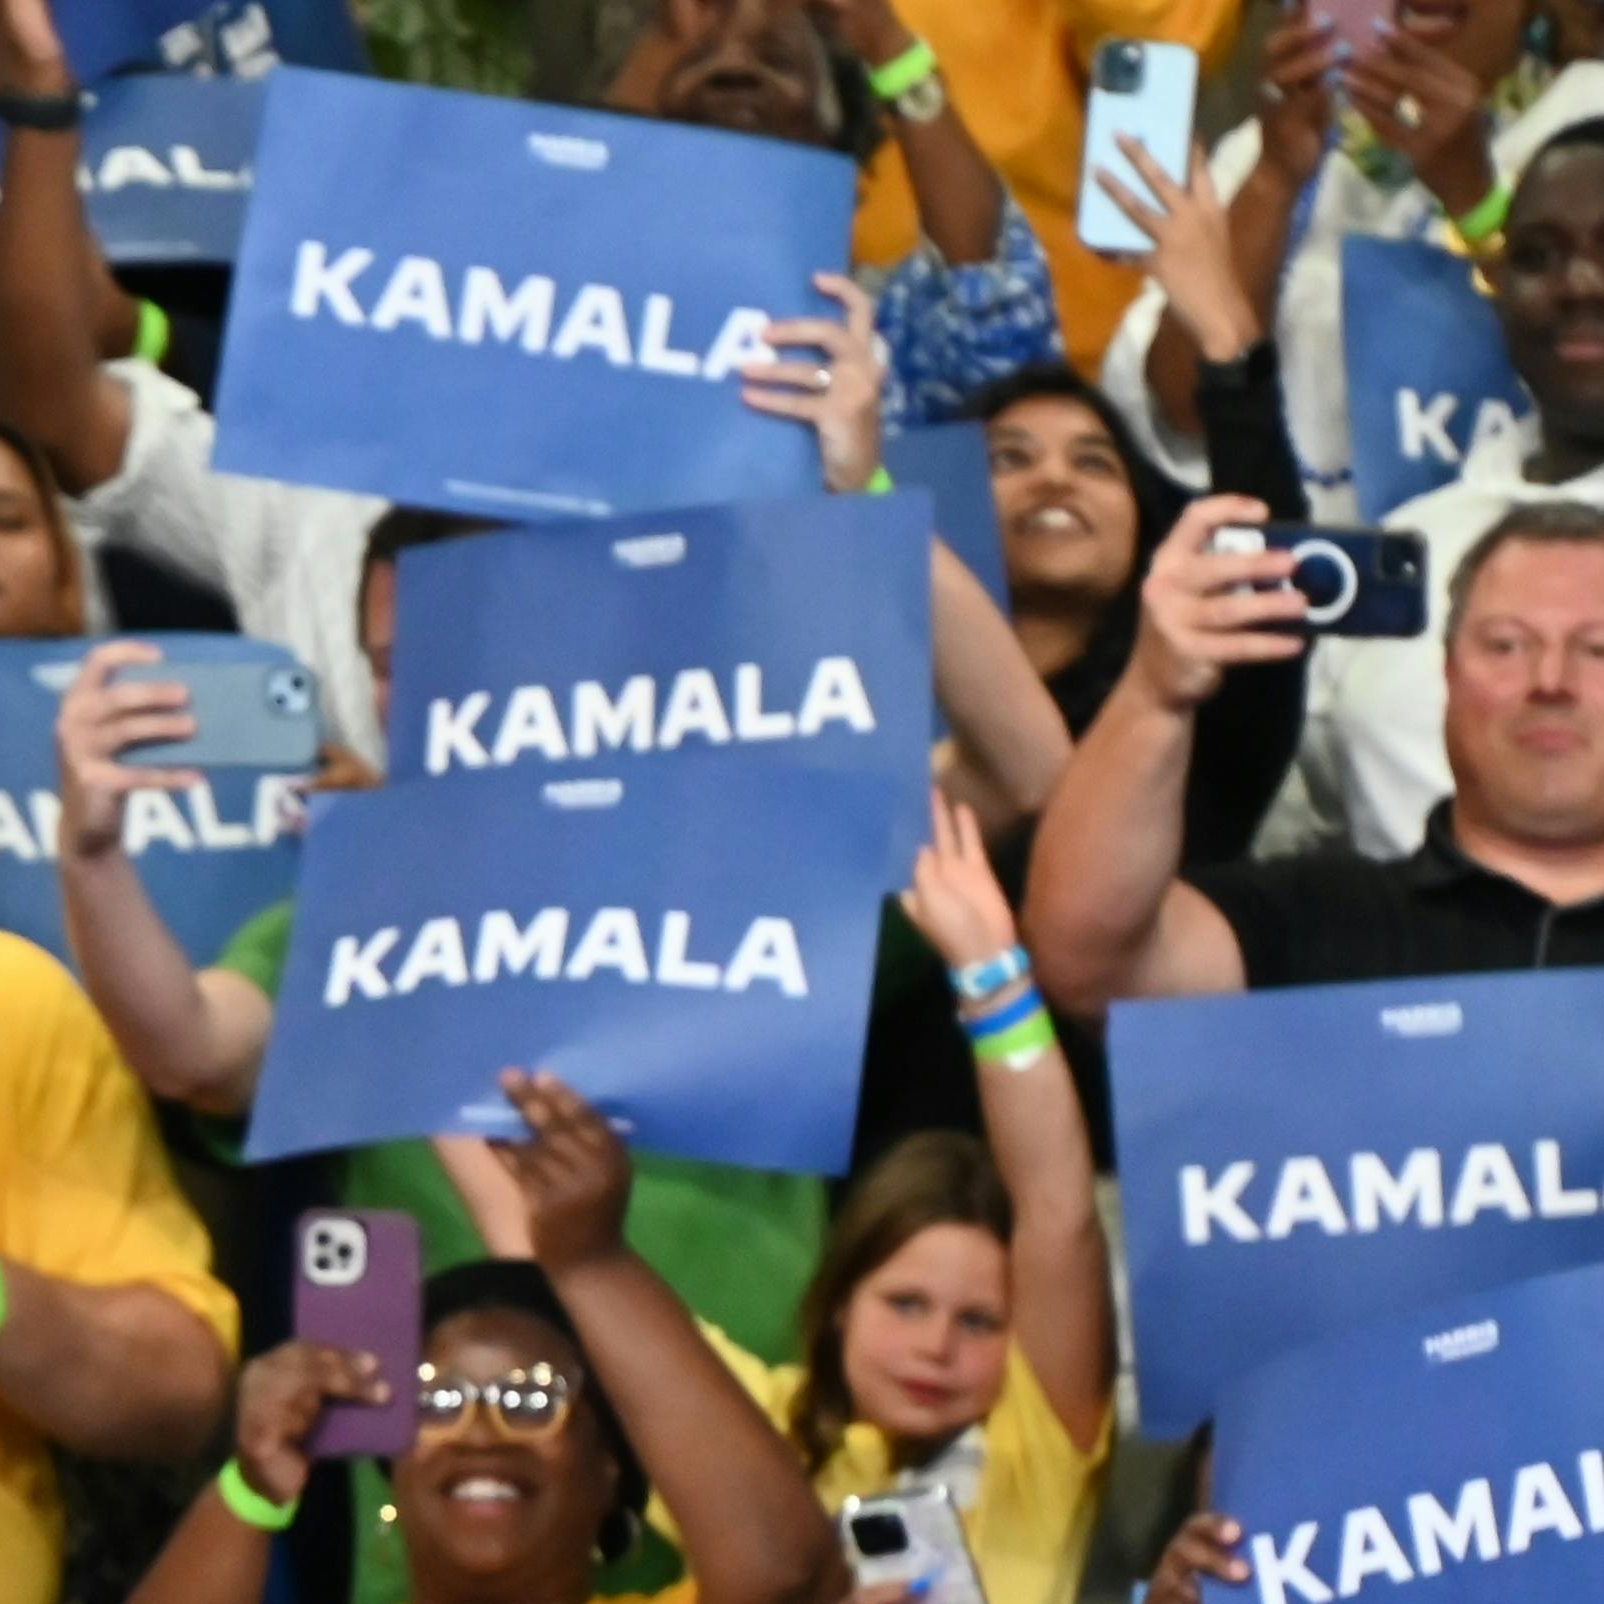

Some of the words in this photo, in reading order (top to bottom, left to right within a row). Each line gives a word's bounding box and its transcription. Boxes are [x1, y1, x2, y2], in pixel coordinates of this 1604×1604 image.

[291, 240, 777, 381] KAMALA
[425, 656, 877, 775] KAMALA
[324, 907, 810, 1007] KAMALA
